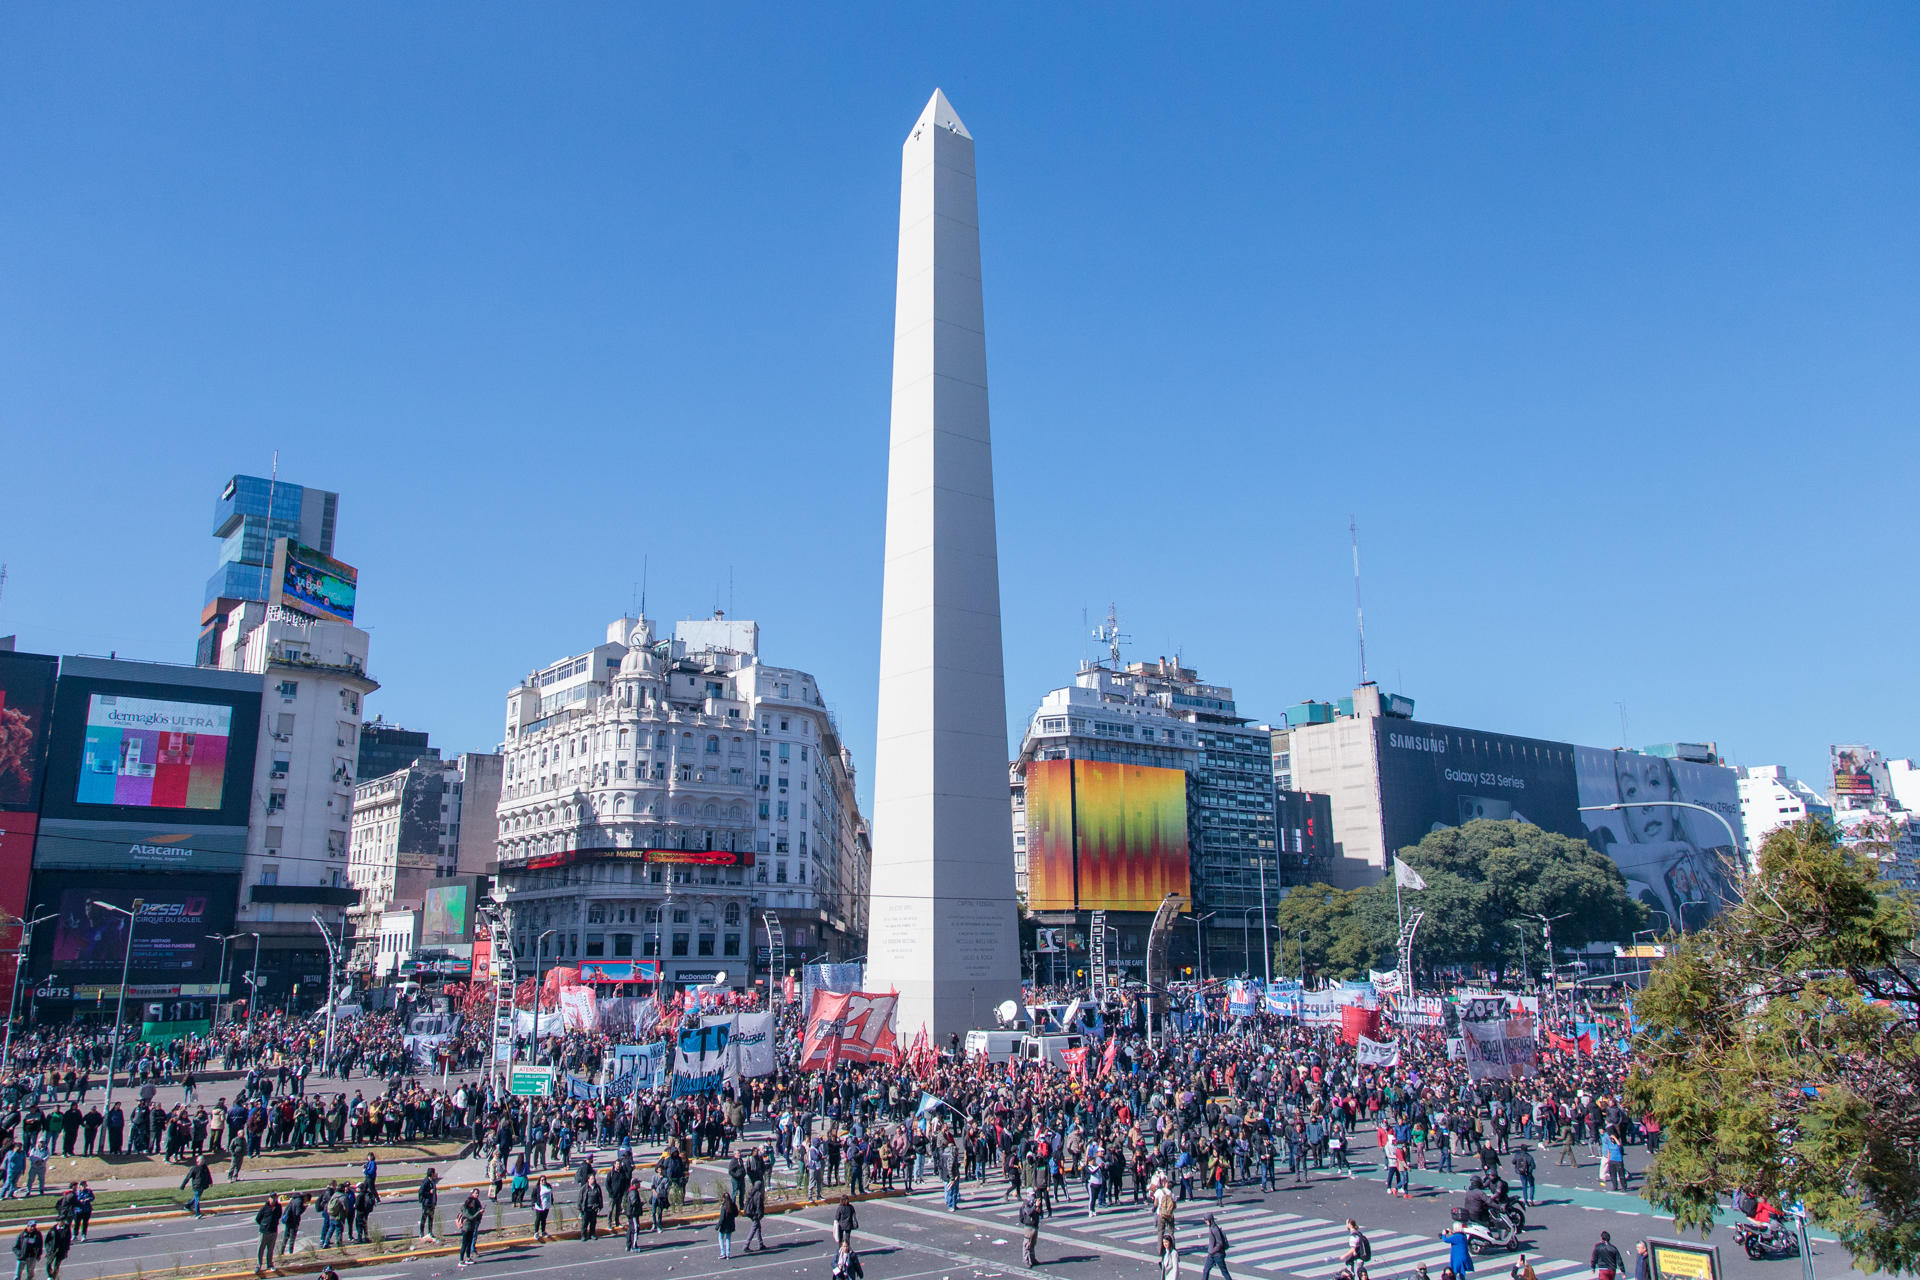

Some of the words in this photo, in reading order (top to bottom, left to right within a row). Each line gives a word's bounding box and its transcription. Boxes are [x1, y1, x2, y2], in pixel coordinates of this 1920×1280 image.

[108, 709, 170, 726] dermaglós
[172, 716, 214, 728] ULTRA
[1390, 733, 1446, 753] SAMSUNG
[1444, 768, 1478, 787] Galaxy
[1480, 773, 1496, 786] S23
[1498, 775, 1525, 789] Series
[129, 844, 192, 856] Atacama
[1664, 1259, 1703, 1268] transformando
